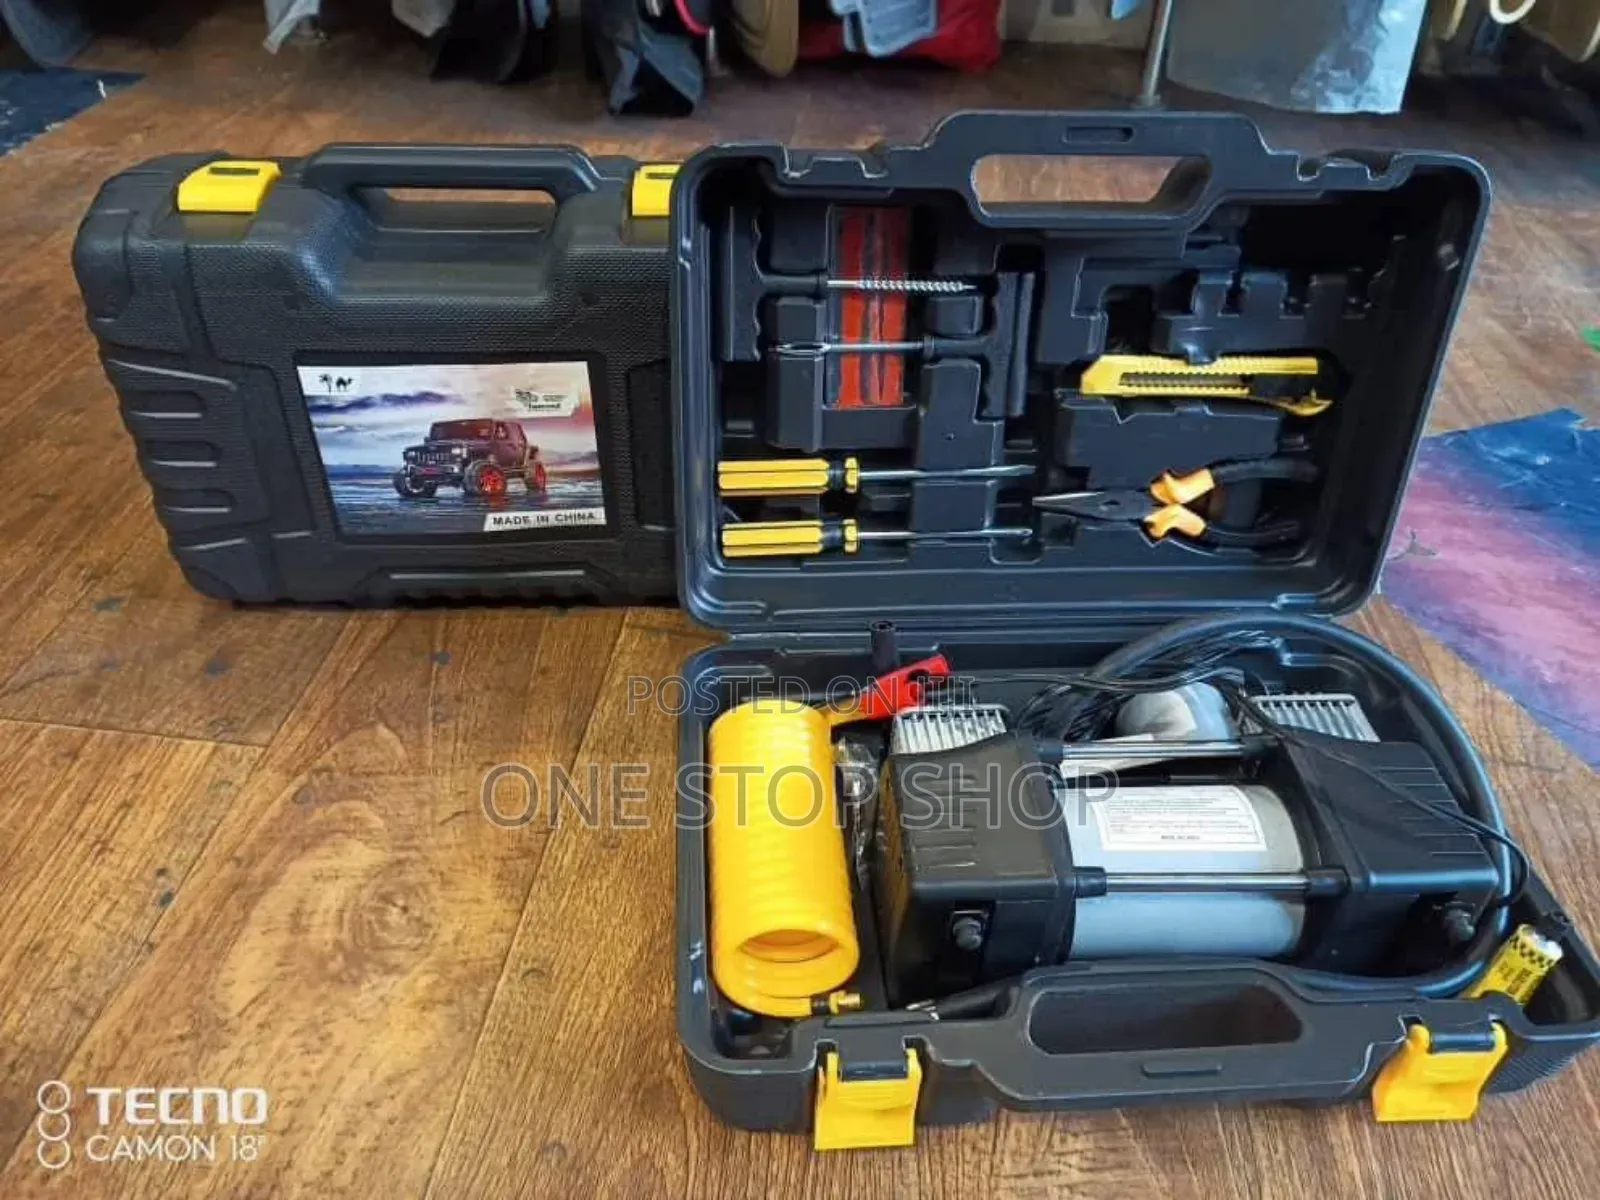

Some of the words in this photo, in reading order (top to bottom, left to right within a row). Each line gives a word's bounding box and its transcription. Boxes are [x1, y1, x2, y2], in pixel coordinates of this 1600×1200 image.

[493, 515, 530, 526] MADE
[536, 514, 549, 524] IN
[555, 511, 595, 523] CHINA
